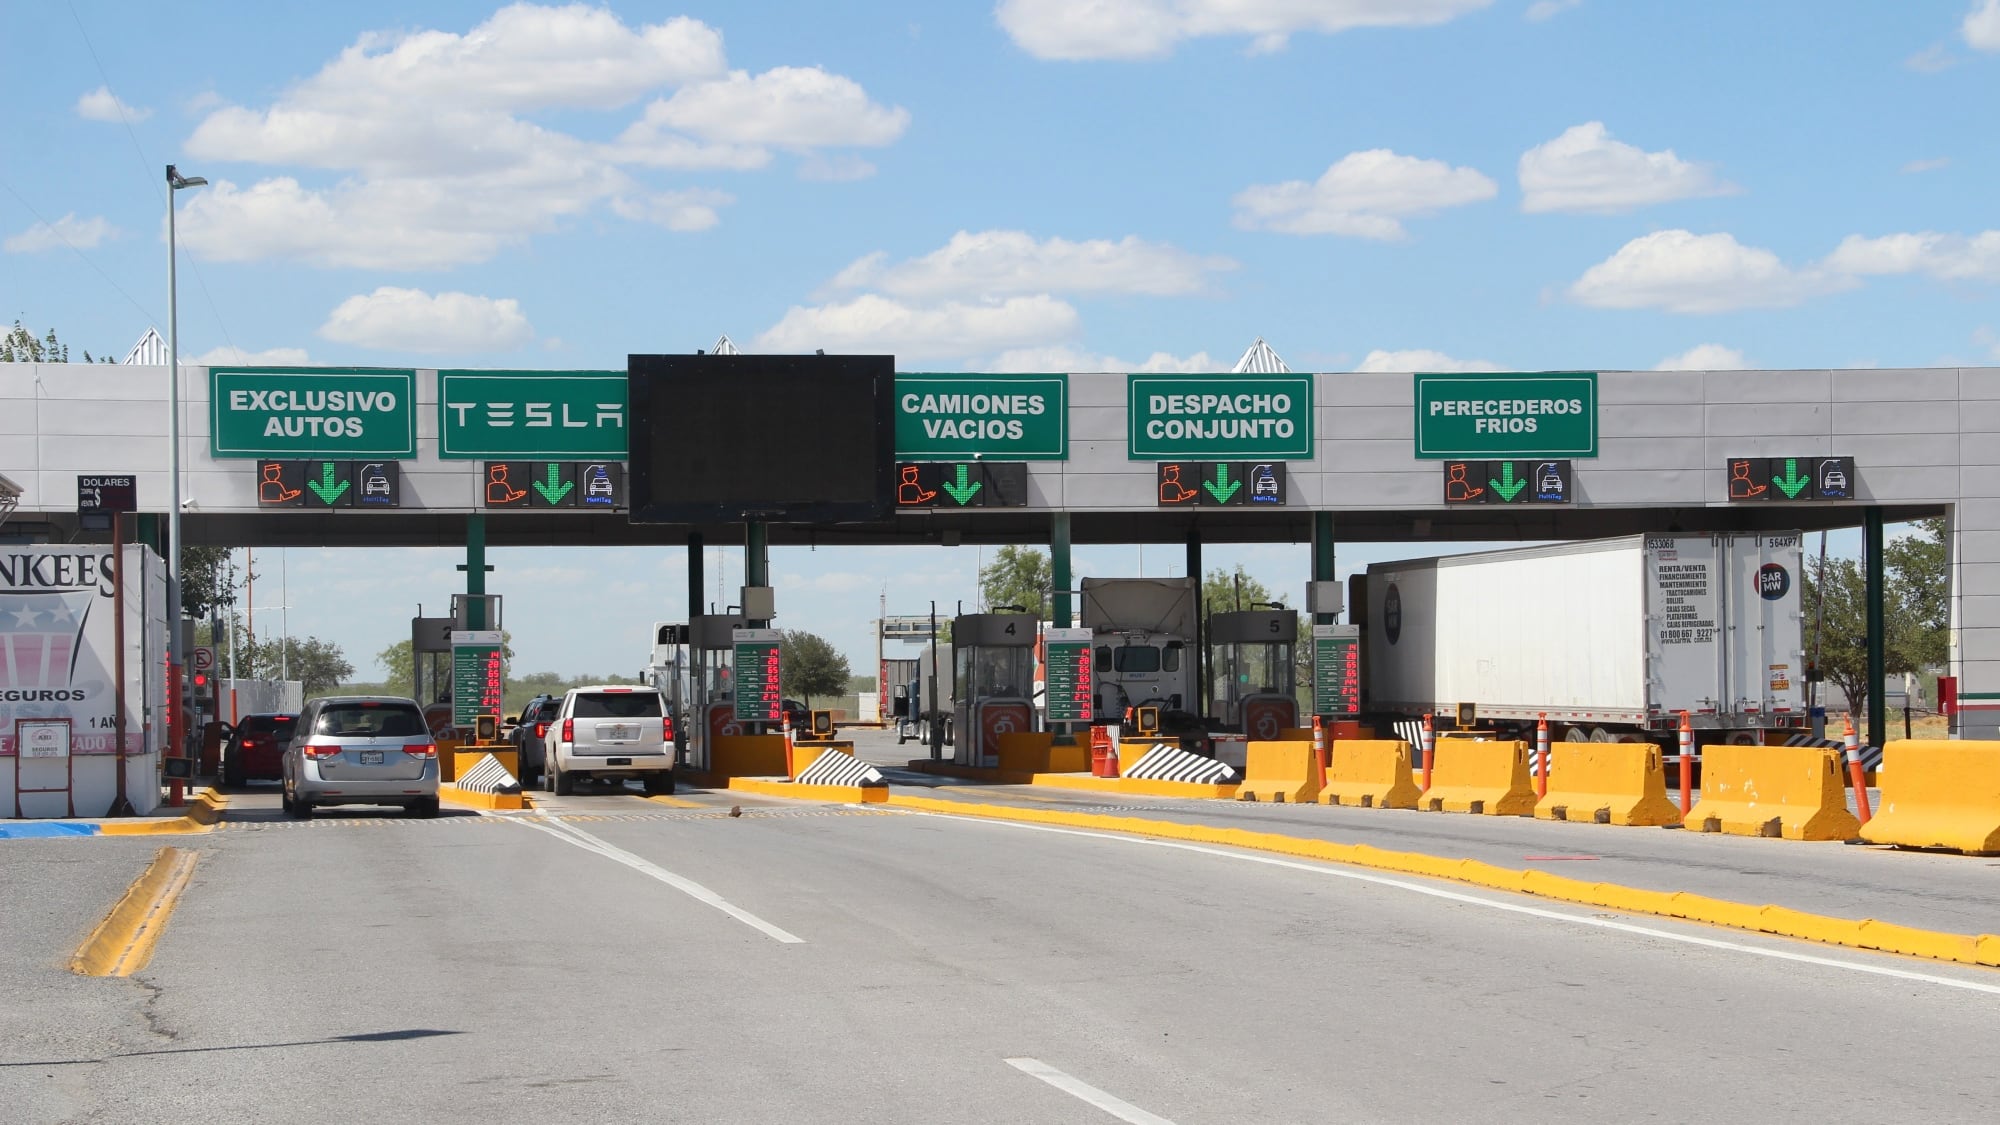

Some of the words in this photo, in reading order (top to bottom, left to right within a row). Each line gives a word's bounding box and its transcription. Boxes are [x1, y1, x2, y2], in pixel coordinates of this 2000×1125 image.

[230, 390, 396, 412] EXCLUSIVO
[901, 393, 1045, 415] CAMIONES
[1149, 393, 1291, 414] DESPACHO
[1430, 399, 1582, 416] PERECEDEROS
[447, 402, 623, 427] TESLA
[263, 416, 364, 437] AUTOS
[922, 419, 1024, 440] VACIOS
[1146, 418, 1294, 440] CONJUNTO
[1475, 417, 1538, 434] FRIOS
[83, 478, 130, 487] DOLARES
[1659, 564, 1706, 572] RENTA/VENTA
[1761, 572, 1781, 583] SAR
[1764, 581, 1781, 591] MW
[1005, 622, 1016, 636] 4
[1270, 620, 1279, 632] 5
[491, 651, 499, 659] 14
[767, 657, 778, 665] 28
[1079, 657, 1090, 665] 28
[488, 660, 499, 668] 28
[488, 670, 499, 678] 65
[0, 690, 85, 701] GUROS
[90, 717, 96, 728] 1
[100, 714, 127, 728] AÑ
